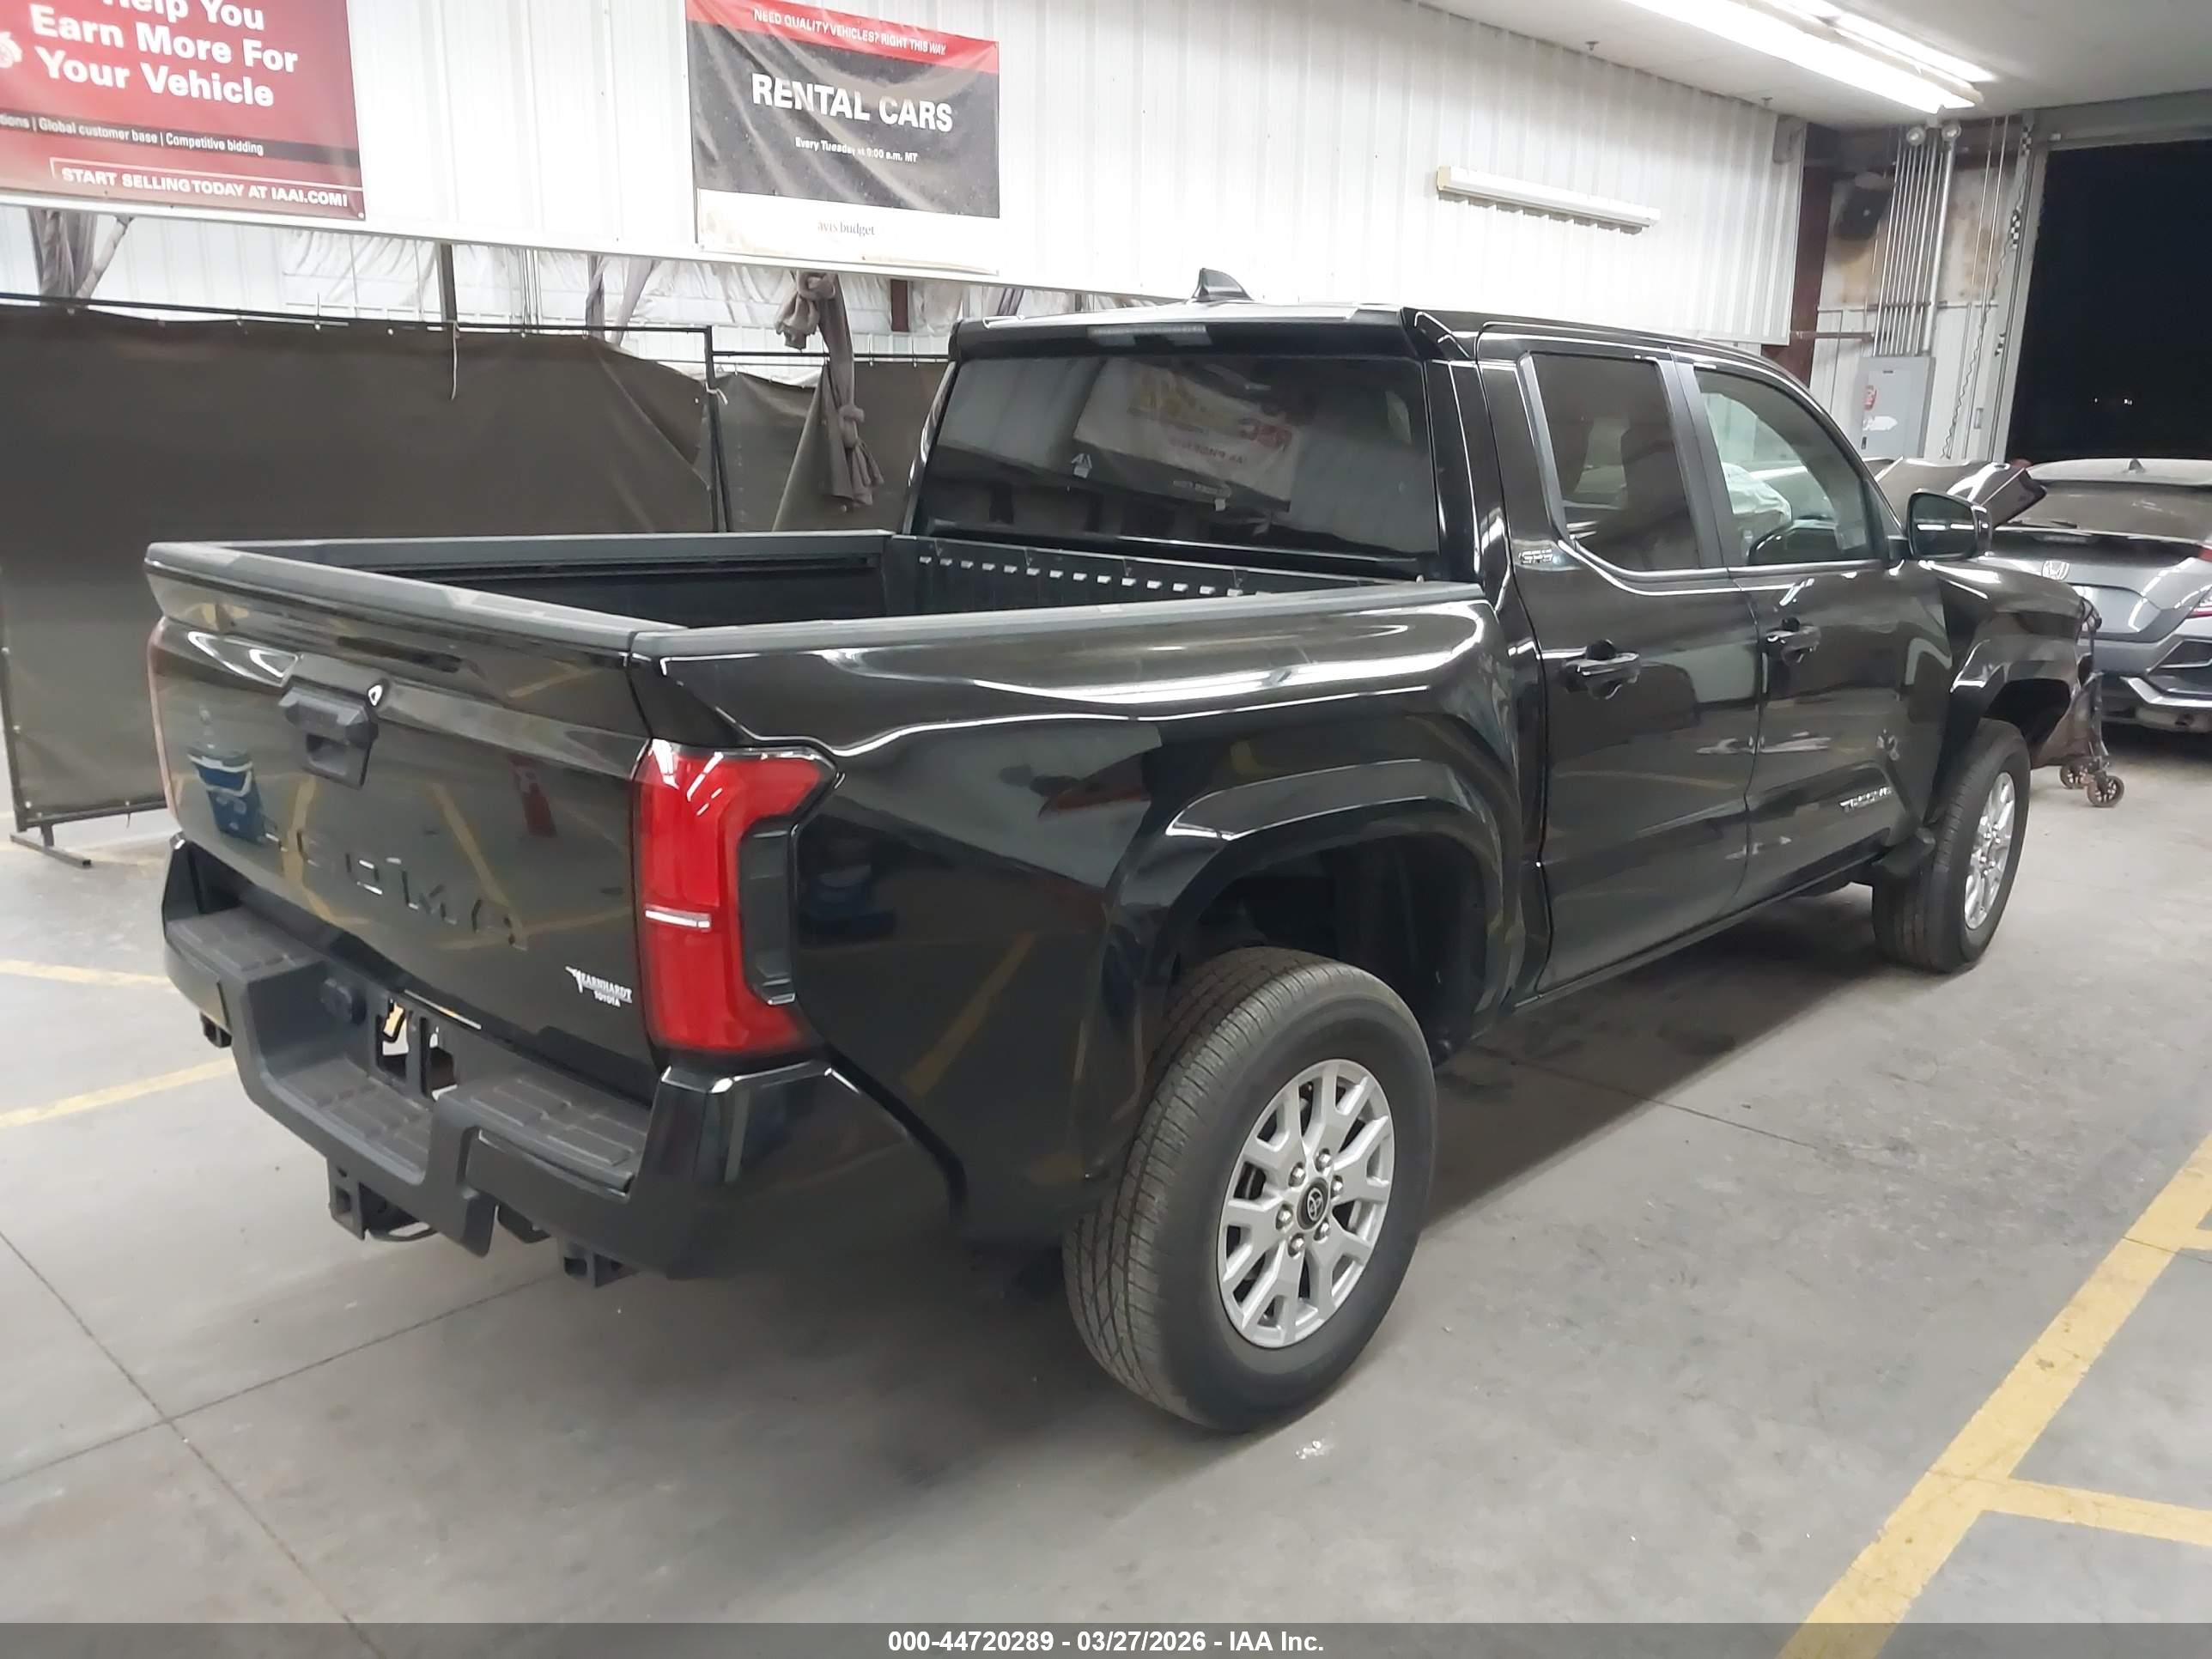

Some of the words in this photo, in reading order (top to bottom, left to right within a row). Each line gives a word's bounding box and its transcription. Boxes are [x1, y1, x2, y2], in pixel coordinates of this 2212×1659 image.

[200, 0, 264, 31] You
[754, 9, 781, 25] NEED
[784, 15, 829, 34] QUALITY
[830, 25, 879, 43] VEHICLES?
[881, 33, 908, 49] RIGHT
[908, 39, 928, 53] THIS
[929, 43, 946, 56] WAY
[29, 3, 124, 49] Earn
[135, 21, 232, 64] More
[242, 39, 299, 73] For
[34, 46, 130, 89] Your
[140, 62, 274, 107] Vehicle
[752, 73, 870, 121] RENTAL
[878, 95, 953, 132] CARS
[39, 117, 76, 134] Global
[79, 125, 130, 142] customer
[131, 130, 157, 144] base
[166, 132, 225, 152] Competitive
[227, 140, 264, 156] bidding
[795, 137, 820, 152] Every
[821, 140, 855, 156] Tuesday
[904, 152, 918, 163] MT
[61, 167, 118, 186] START
[122, 173, 191, 192] SELLING
[191, 179, 245, 198] TODAY
[248, 185, 268, 199] AT
[817, 221, 838, 234] avis
[840, 221, 875, 237] budget
